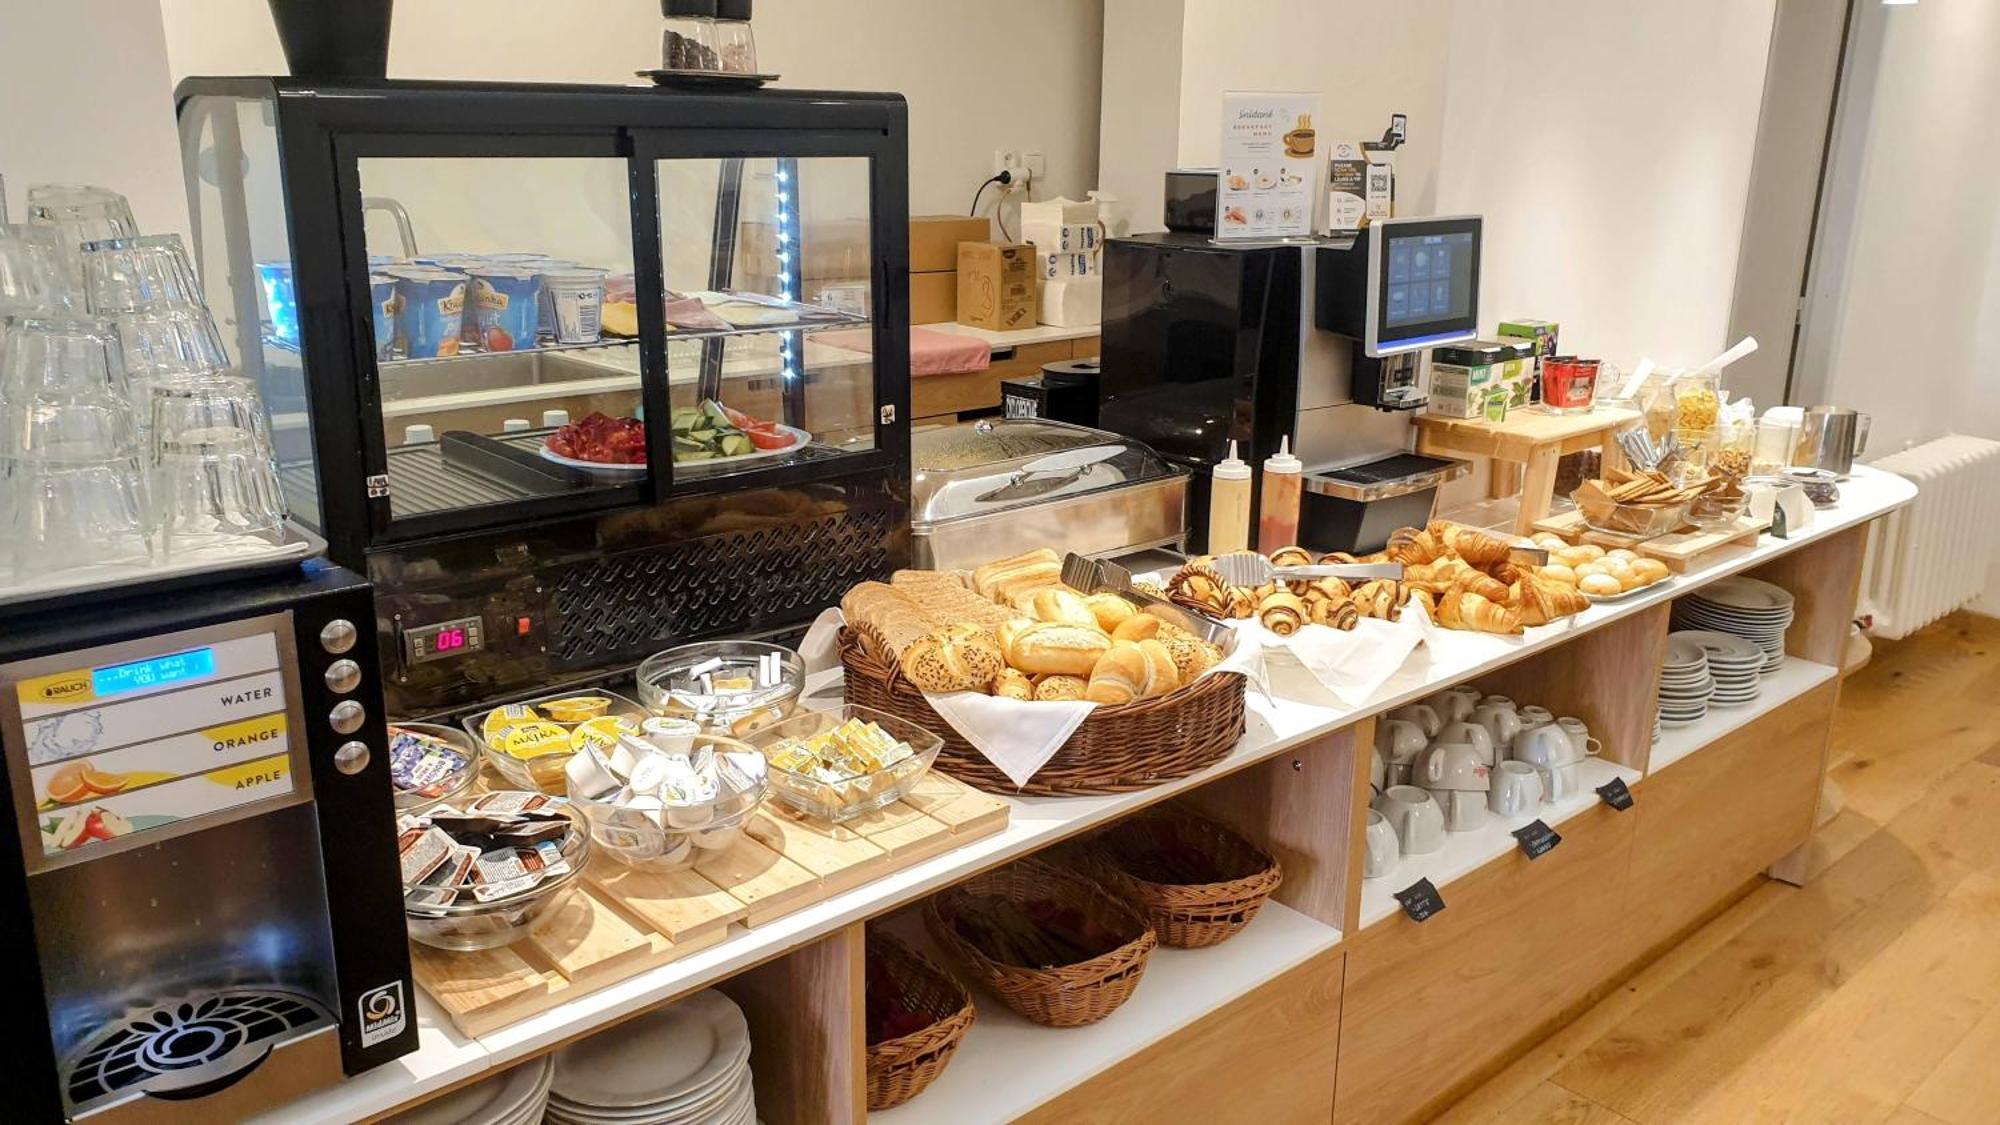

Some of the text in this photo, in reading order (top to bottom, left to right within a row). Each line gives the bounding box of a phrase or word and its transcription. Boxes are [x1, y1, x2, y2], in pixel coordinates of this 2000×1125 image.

[437, 629, 463, 651] 06
[53, 681, 87, 696] RAUCH
[220, 687, 272, 706] WATER
[213, 728, 279, 752] ORANGE
[235, 769, 281, 790] APPLE
